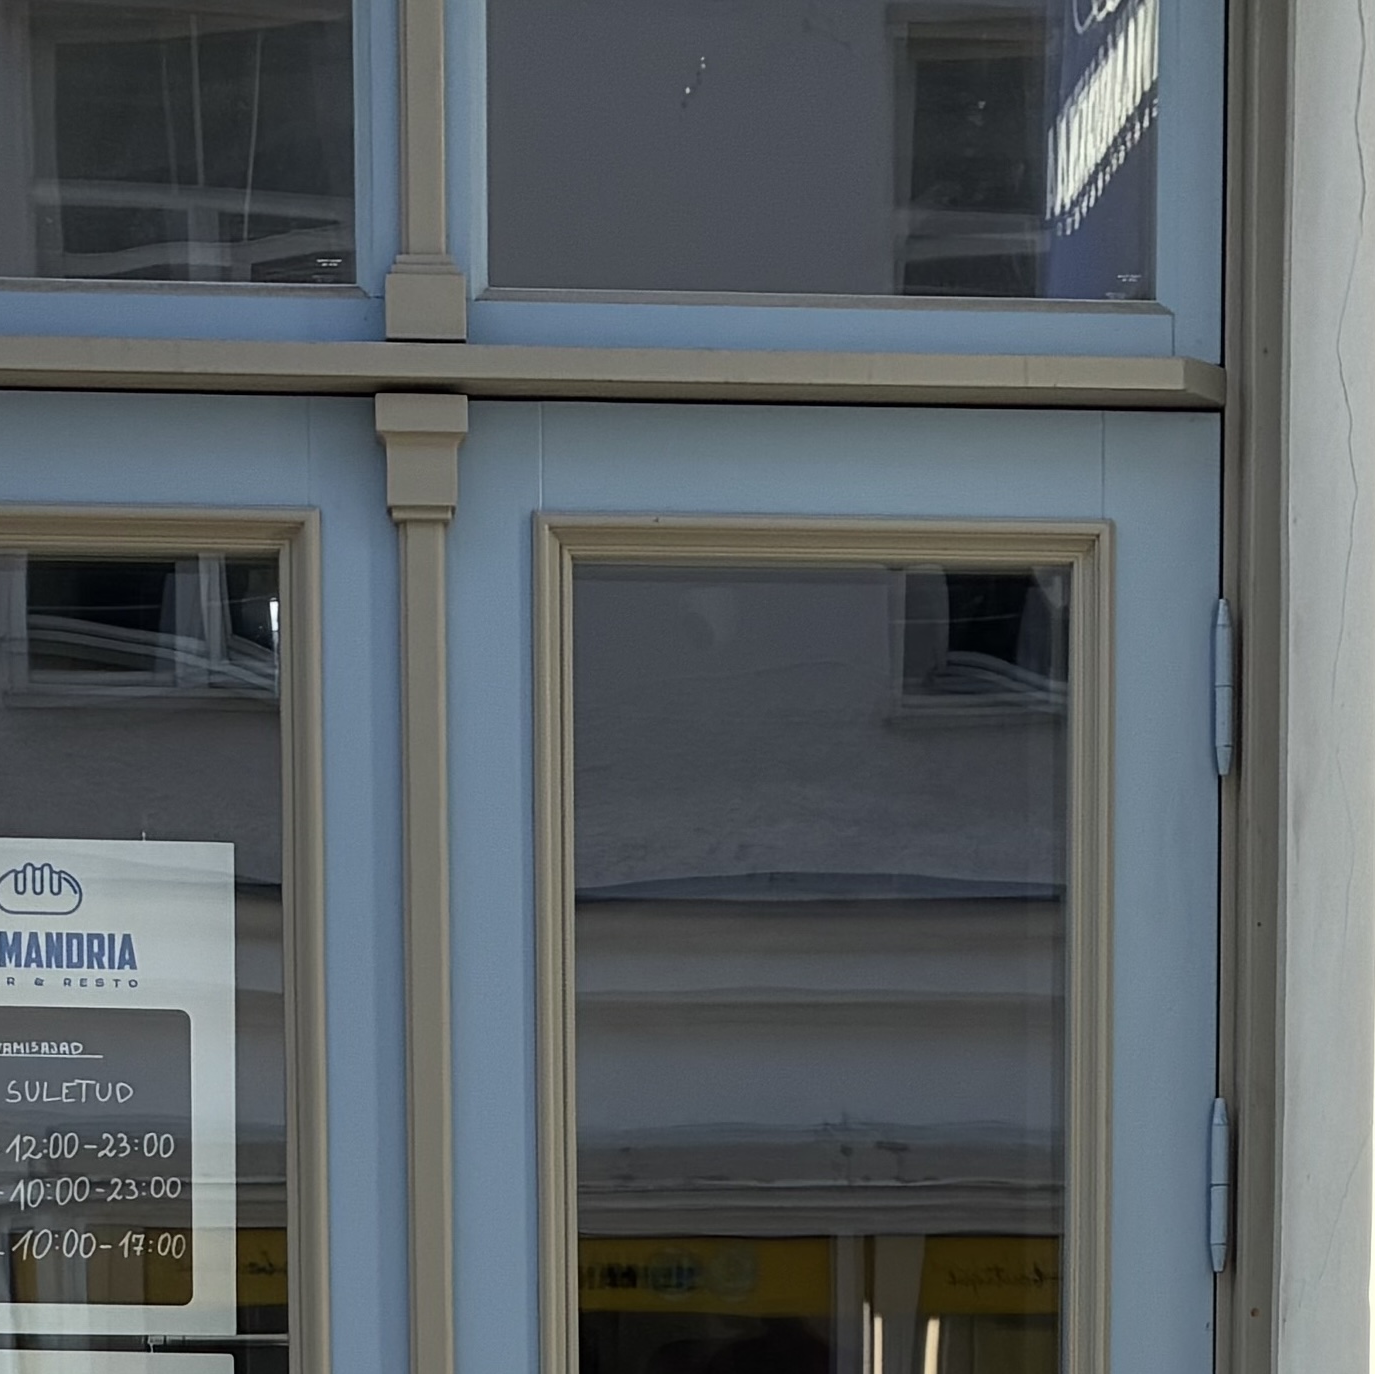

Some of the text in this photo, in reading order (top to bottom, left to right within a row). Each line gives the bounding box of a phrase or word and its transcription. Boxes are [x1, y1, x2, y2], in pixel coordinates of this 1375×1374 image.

[34, 978, 44, 986] &
[63, 978, 139, 988] RESTO
[5, 1079, 134, 1103] SULETUD
